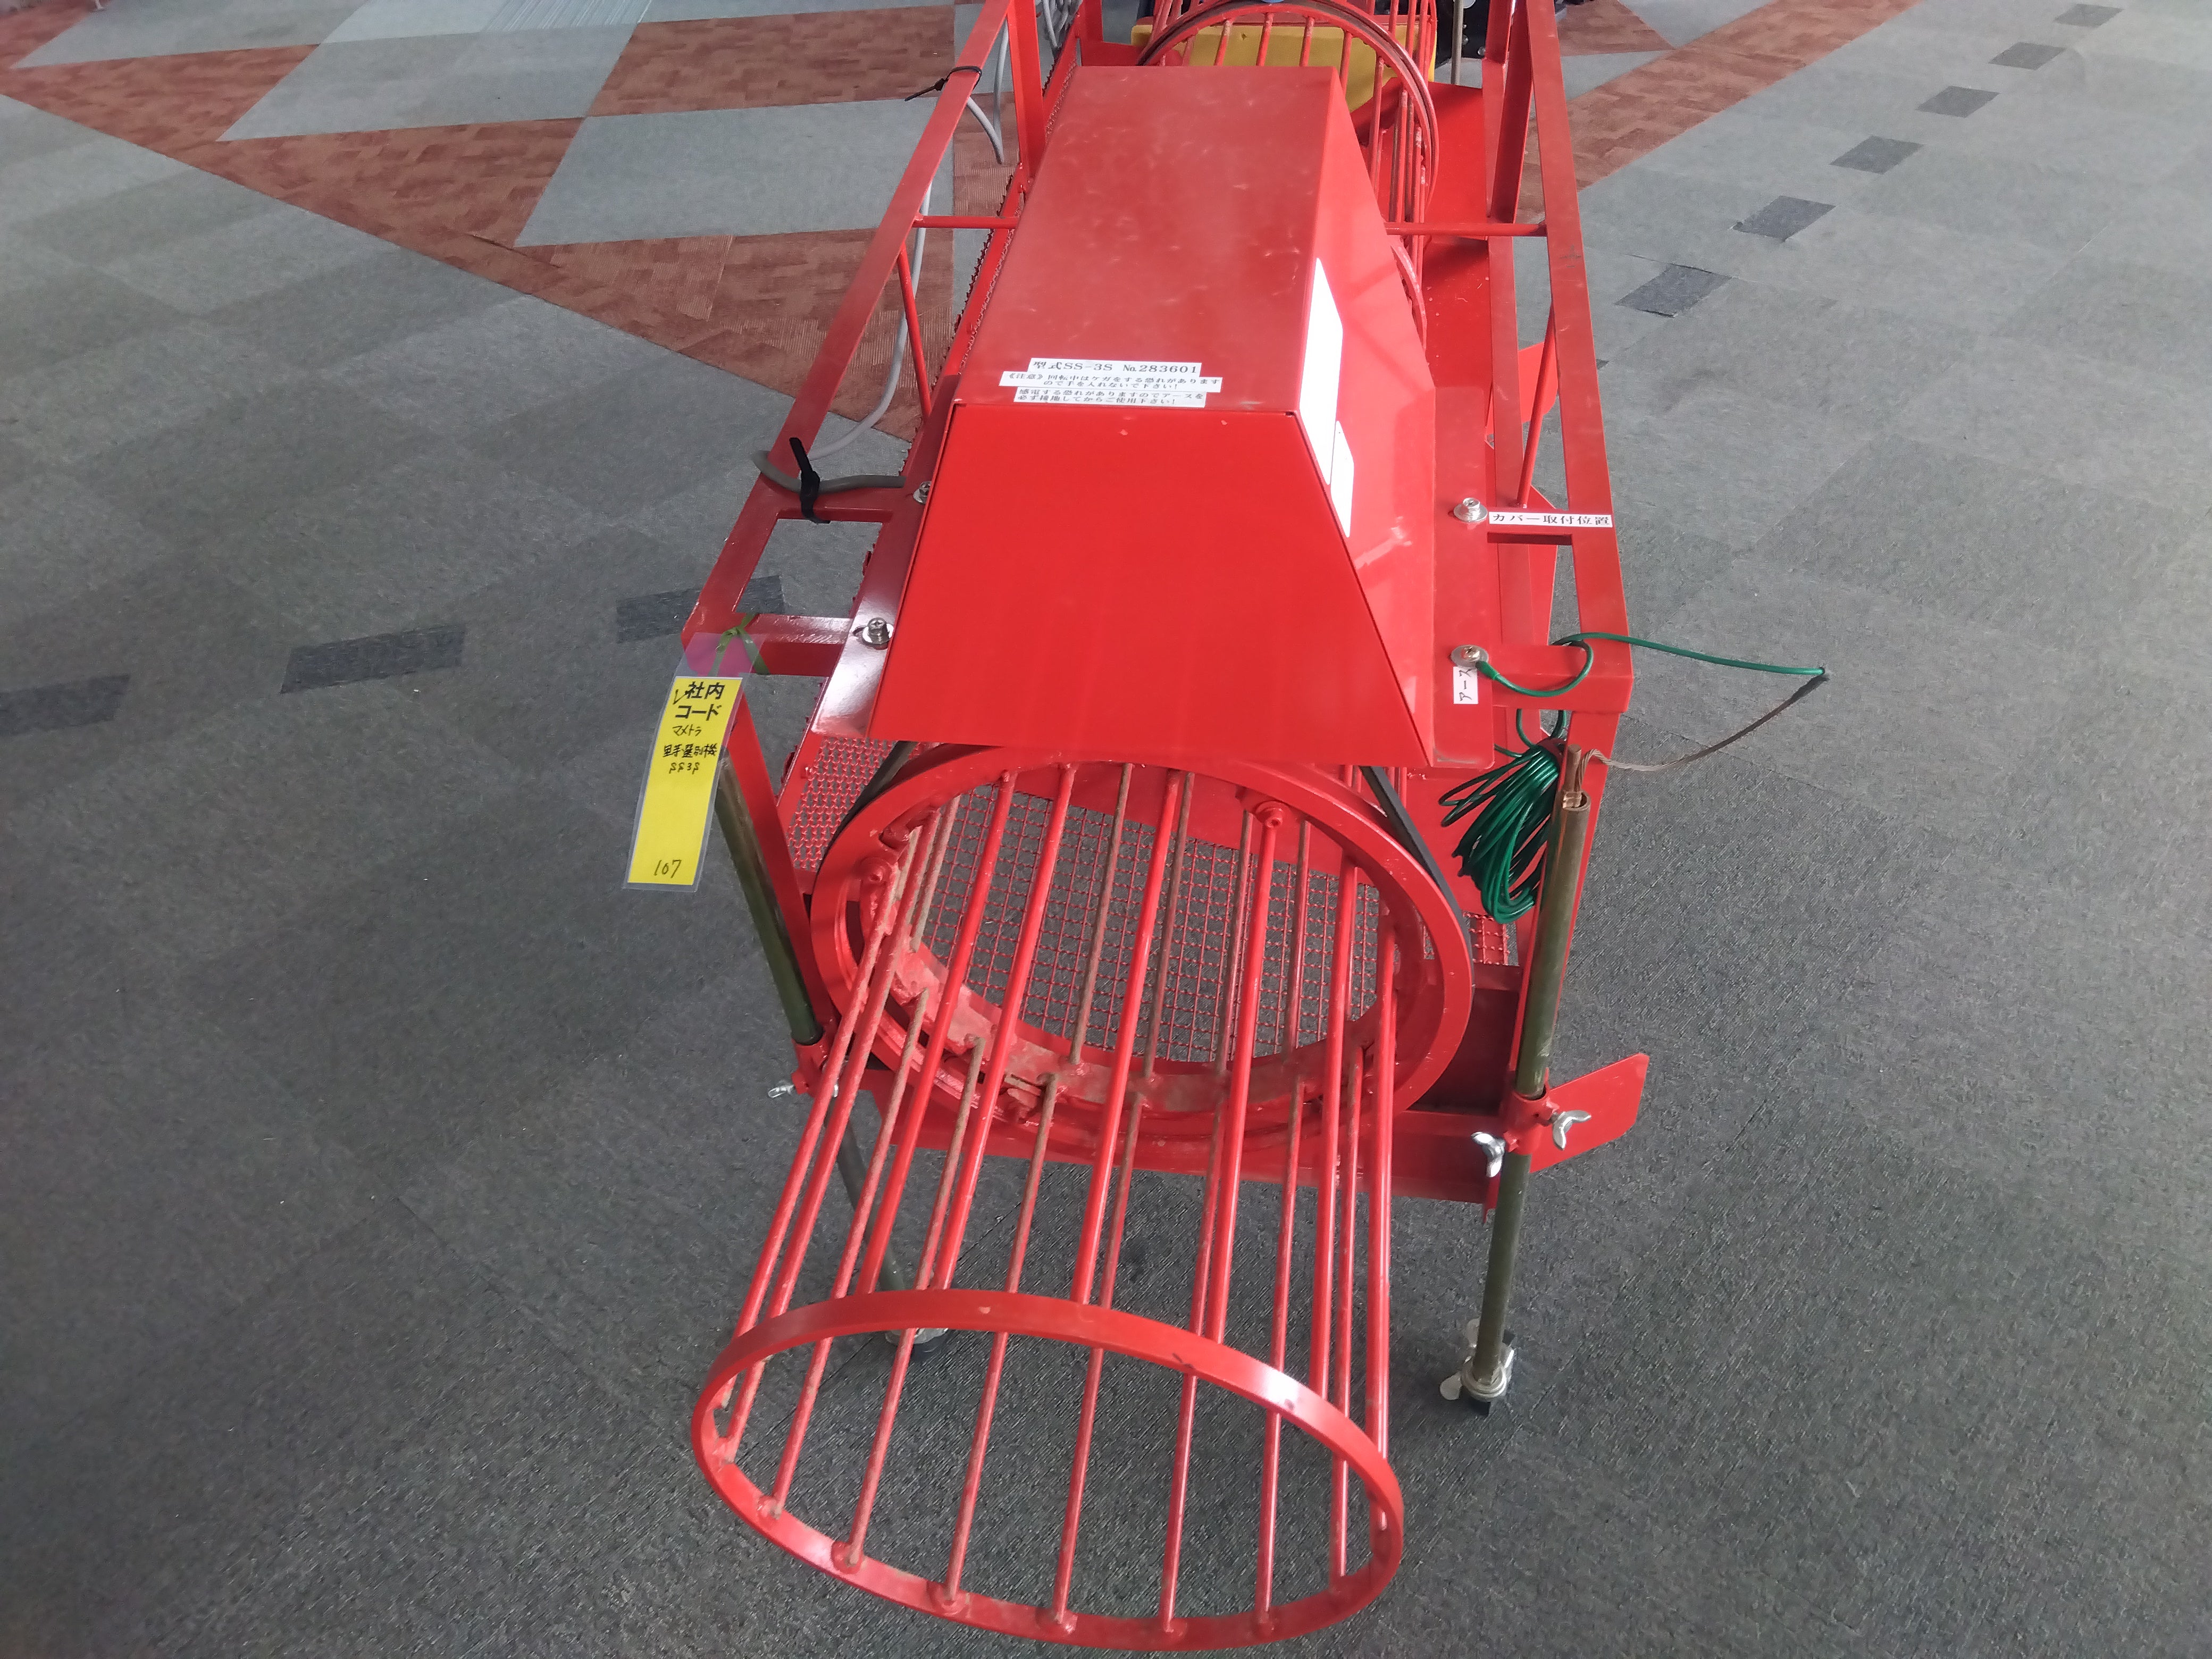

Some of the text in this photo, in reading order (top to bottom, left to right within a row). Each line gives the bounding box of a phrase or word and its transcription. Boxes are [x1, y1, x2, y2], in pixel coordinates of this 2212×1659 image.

[1493, 514, 1610, 525] カバー取付位置
[684, 681, 725, 700] 社内
[1459, 668, 1472, 701] アース
[675, 703, 722, 722] コード
[672, 724, 702, 737] マメトラ
[653, 859, 682, 879] 107
